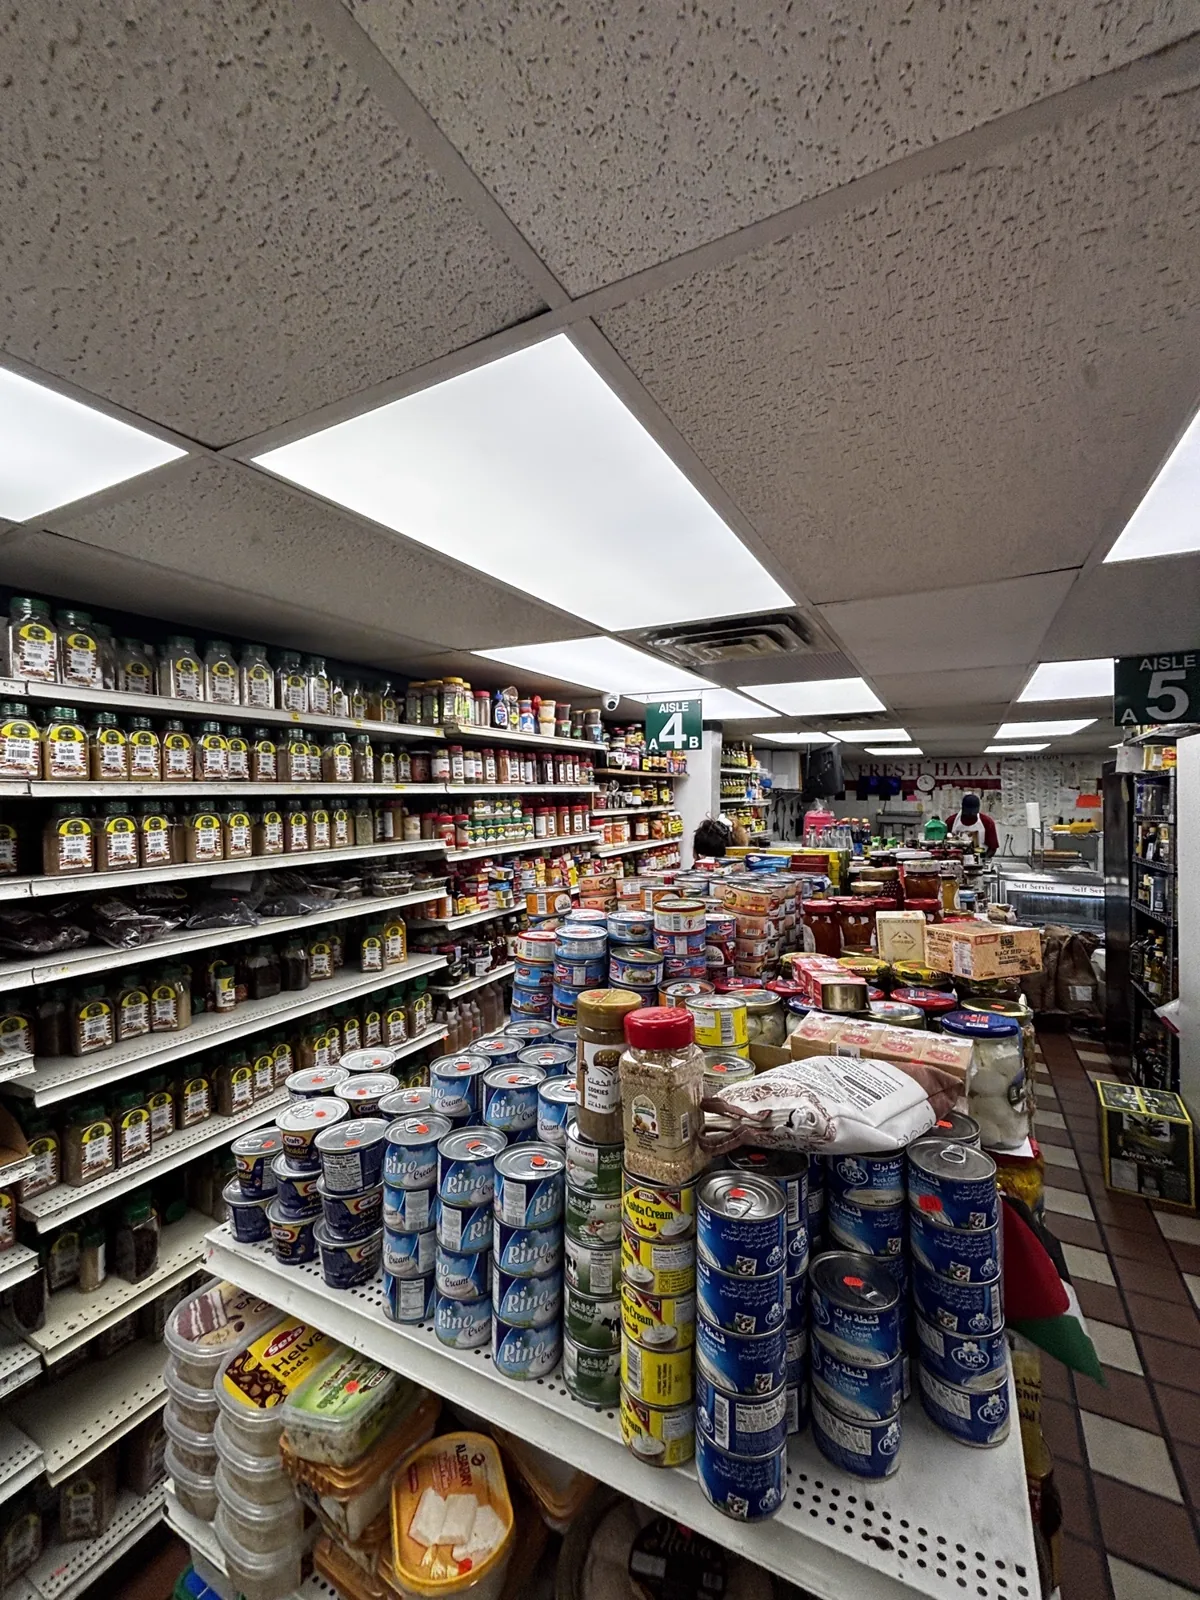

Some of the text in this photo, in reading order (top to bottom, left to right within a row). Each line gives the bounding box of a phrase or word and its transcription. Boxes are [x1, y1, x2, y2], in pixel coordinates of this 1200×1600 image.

[1139, 654, 1196, 671] AISLE
[1120, 669, 1190, 723] A 5
[659, 702, 689, 713] AISLE
[649, 712, 699, 750] A 4 B
[858, 762, 923, 777] FRESH
[588, 1086, 609, 1096] COOKIES
[490, 1101, 526, 1119] Rino
[540, 1121, 560, 1131] Cream
[286, 1136, 300, 1145] Kraft
[574, 1146, 595, 1157] Cream
[385, 1156, 417, 1174] Rino
[447, 1174, 486, 1194] Rino
[645, 1205, 674, 1221] Cream
[388, 1256, 410, 1265] Cream
[507, 1243, 549, 1264] Rino
[444, 1276, 469, 1288] Cream
[506, 1290, 549, 1313] Rino
[438, 1310, 474, 1330] Rino
[629, 1306, 654, 1328] Cream
[854, 1313, 880, 1324] قشطة
[268, 1326, 304, 1355] Sera
[851, 1329, 873, 1339] Cream
[271, 1332, 326, 1372] Helva
[503, 1341, 545, 1363] Rino
[957, 1351, 985, 1364] Puck
[281, 1356, 310, 1378] Sade
[983, 1406, 1004, 1418] Puck
